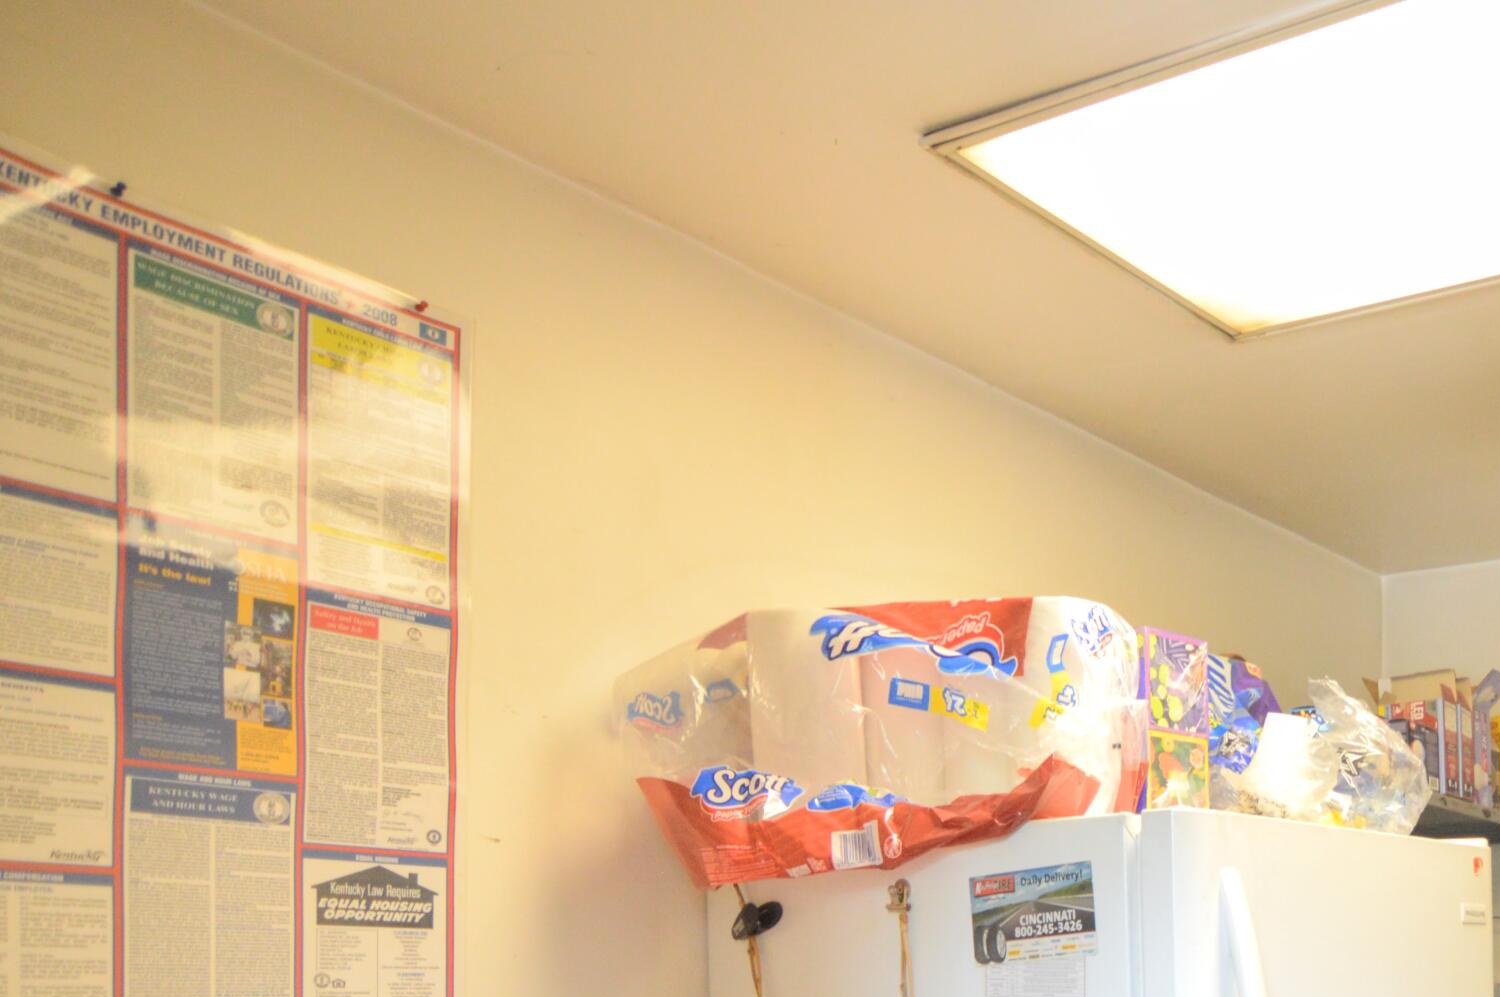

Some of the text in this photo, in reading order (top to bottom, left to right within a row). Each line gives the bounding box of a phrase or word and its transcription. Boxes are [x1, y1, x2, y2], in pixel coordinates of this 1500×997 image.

[0, 160, 398, 326] ENTKY EMPLOYMENT REGULATIONS 2008
[168, 551, 214, 571] Health
[161, 566, 182, 581] the
[148, 785, 239, 802] KENTUCKY WAGE
[707, 768, 790, 804] Scott
[152, 799, 236, 814] AND HOUR LAWS
[1020, 869, 1084, 888] Daily Delivery!
[330, 881, 421, 900] Kentucky Law Requires
[318, 897, 433, 914] EQUAL HOUSING
[324, 909, 426, 923] OPPORTUNITY
[1019, 909, 1076, 926] CINCINNATI
[1014, 920, 1083, 938] 800-245-3426
